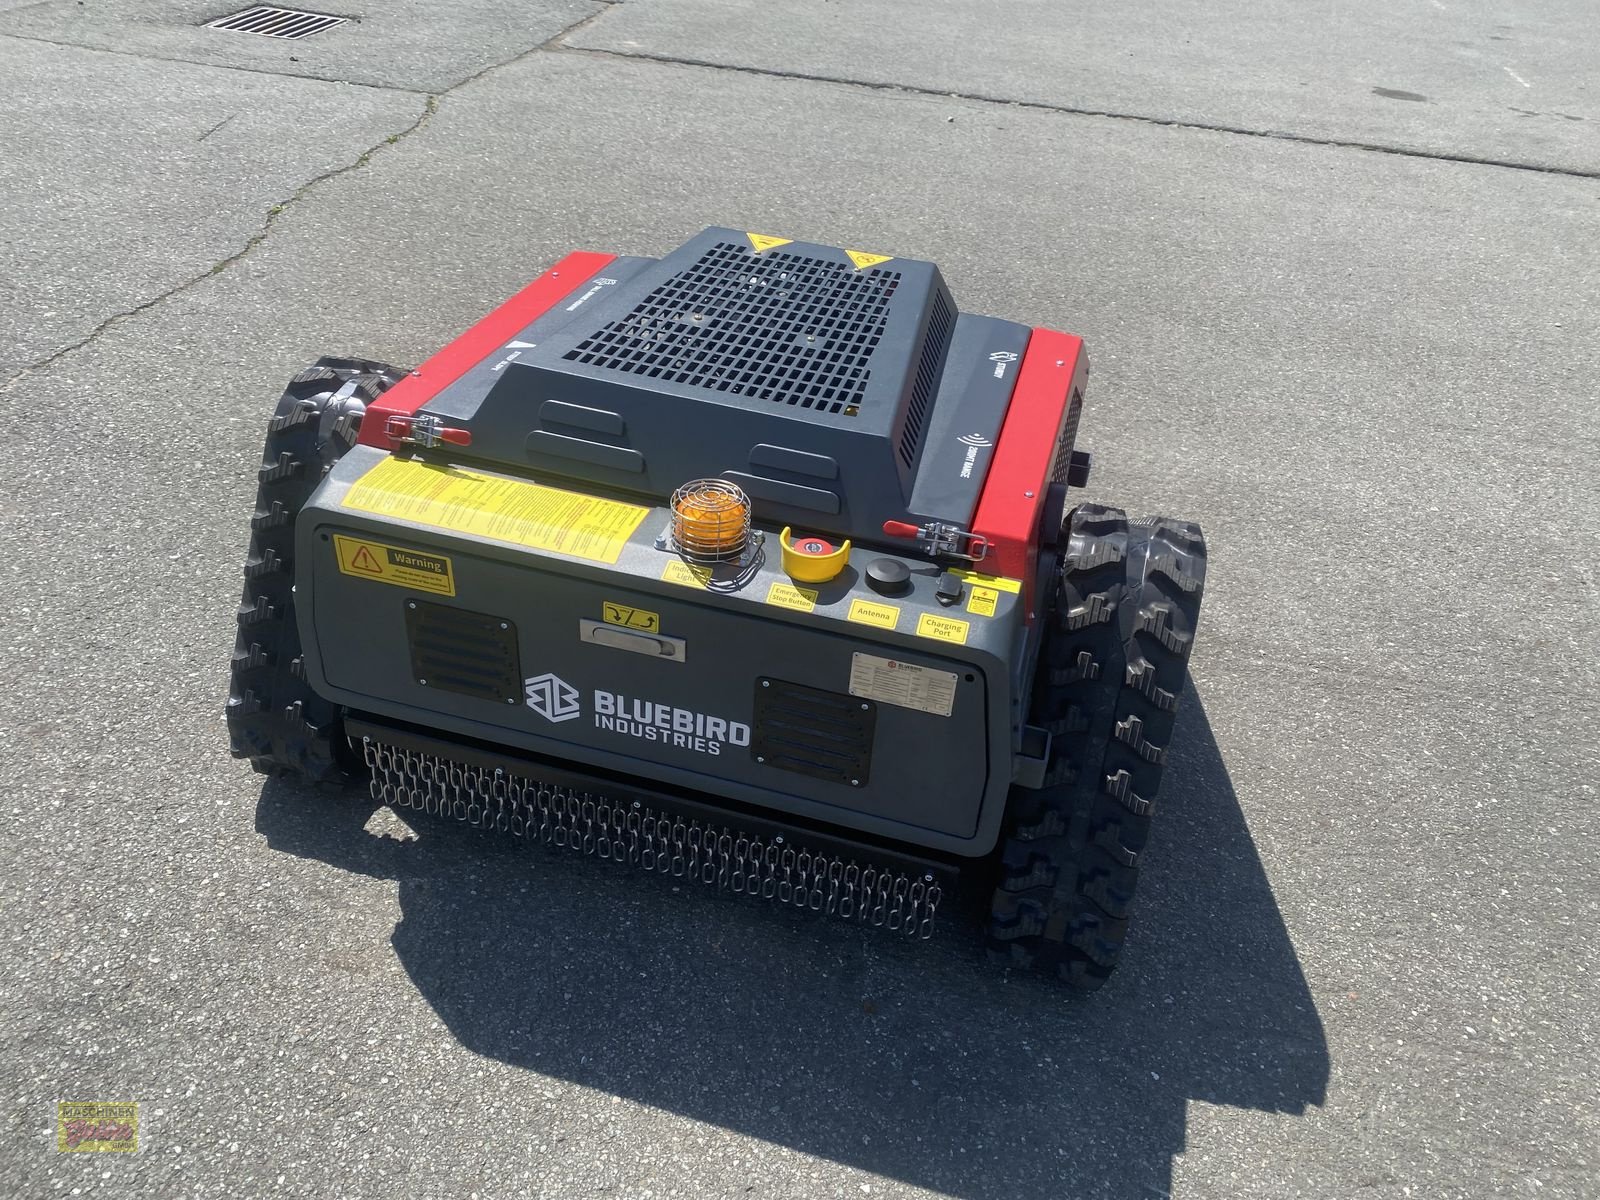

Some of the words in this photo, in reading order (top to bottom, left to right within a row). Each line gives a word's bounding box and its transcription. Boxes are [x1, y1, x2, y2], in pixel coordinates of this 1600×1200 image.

[394, 552, 442, 573] Warning
[676, 572, 696, 583] Light
[775, 588, 812, 601] Emergency
[788, 597, 811, 607] Button
[857, 607, 891, 621] Antenna
[925, 619, 962, 633] Charging
[933, 627, 951, 637] Port
[594, 689, 751, 748] BLUEBIRD
[594, 713, 721, 756] INDUSTRIES
